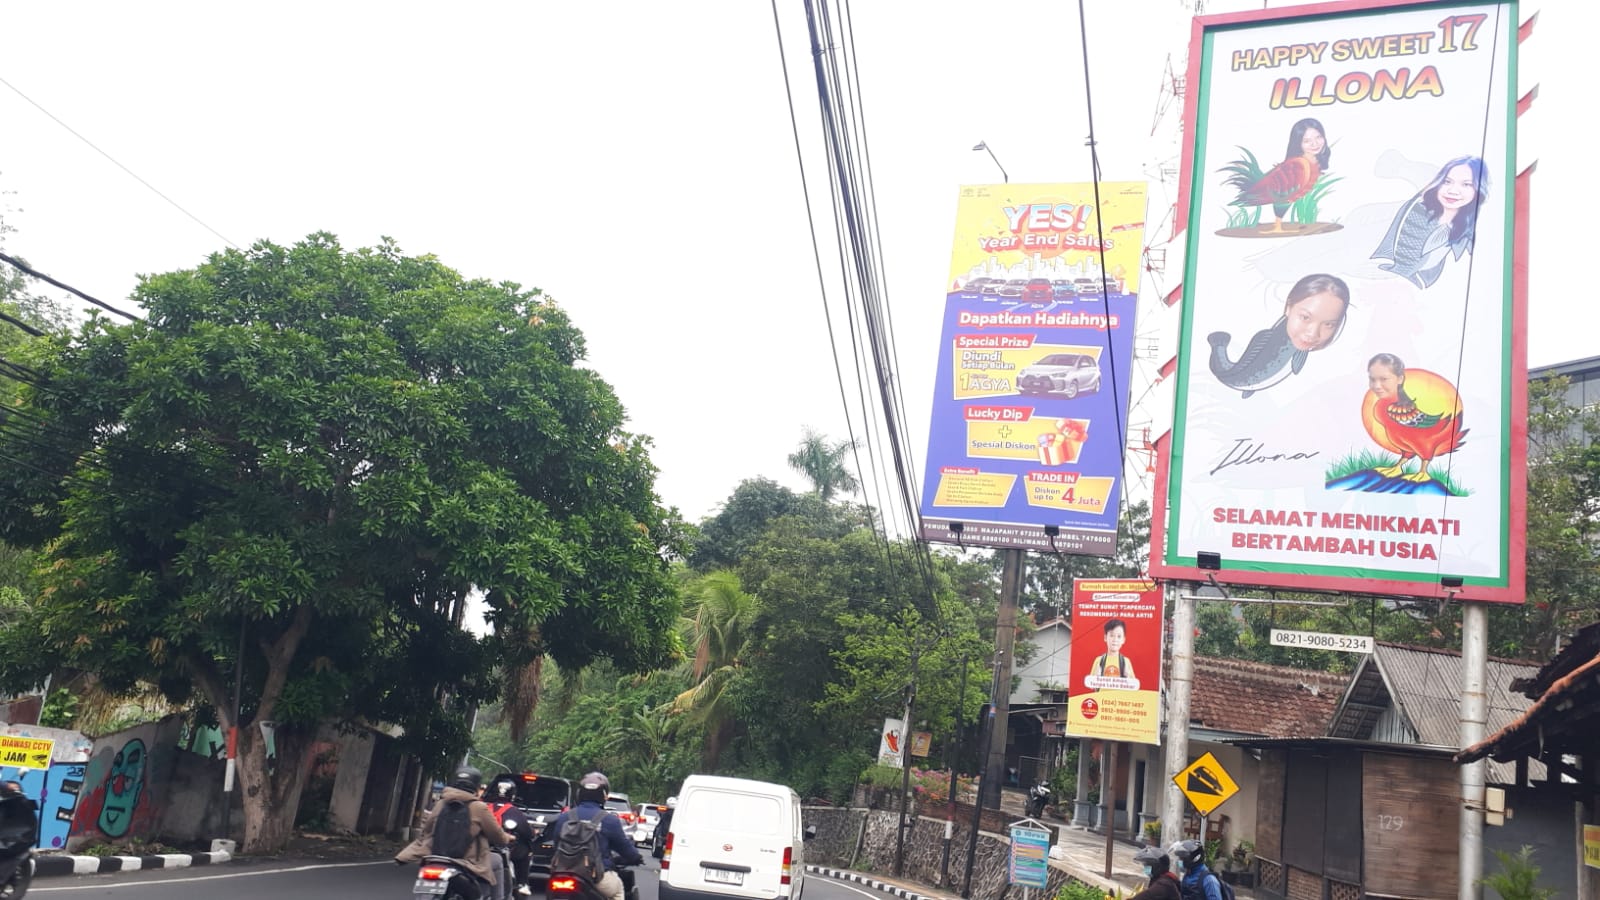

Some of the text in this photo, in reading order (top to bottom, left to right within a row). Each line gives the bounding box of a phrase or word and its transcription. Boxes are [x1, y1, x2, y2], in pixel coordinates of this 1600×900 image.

[1232, 14, 1487, 72] HAPPY SWEET 17
[1269, 66, 1444, 110] ILLONA
[1003, 204, 1094, 232] YES!
[979, 233, 1114, 251] Year End Sales
[959, 311, 1119, 328] Dapatkan Hadiahnya
[959, 336, 1029, 347] Special Prize
[962, 350, 1002, 361] Diundi
[962, 360, 1015, 370] Setiap Bulan
[969, 378, 1011, 391] AGYA
[968, 407, 1023, 421] Lucky Dip
[972, 440, 1036, 450] Spesial Diskon
[1210, 438, 1320, 476] Illona
[1031, 472, 1075, 483] TRADE IN
[1034, 486, 1075, 504] Diskon 4
[1077, 496, 1101, 506] Juta
[1213, 507, 1460, 537] SELAMAT MENIKMATI
[981, 527, 1019, 535] MAJAPAHIT
[1231, 532, 1438, 561] BERTAMBAH USIA
[1275, 632, 1367, 649] 0821-9080-5234
[1, 738, 52, 751] DIAWASI CCTV
[4, 751, 27, 762] JAM
[1377, 814, 1404, 831] 129
